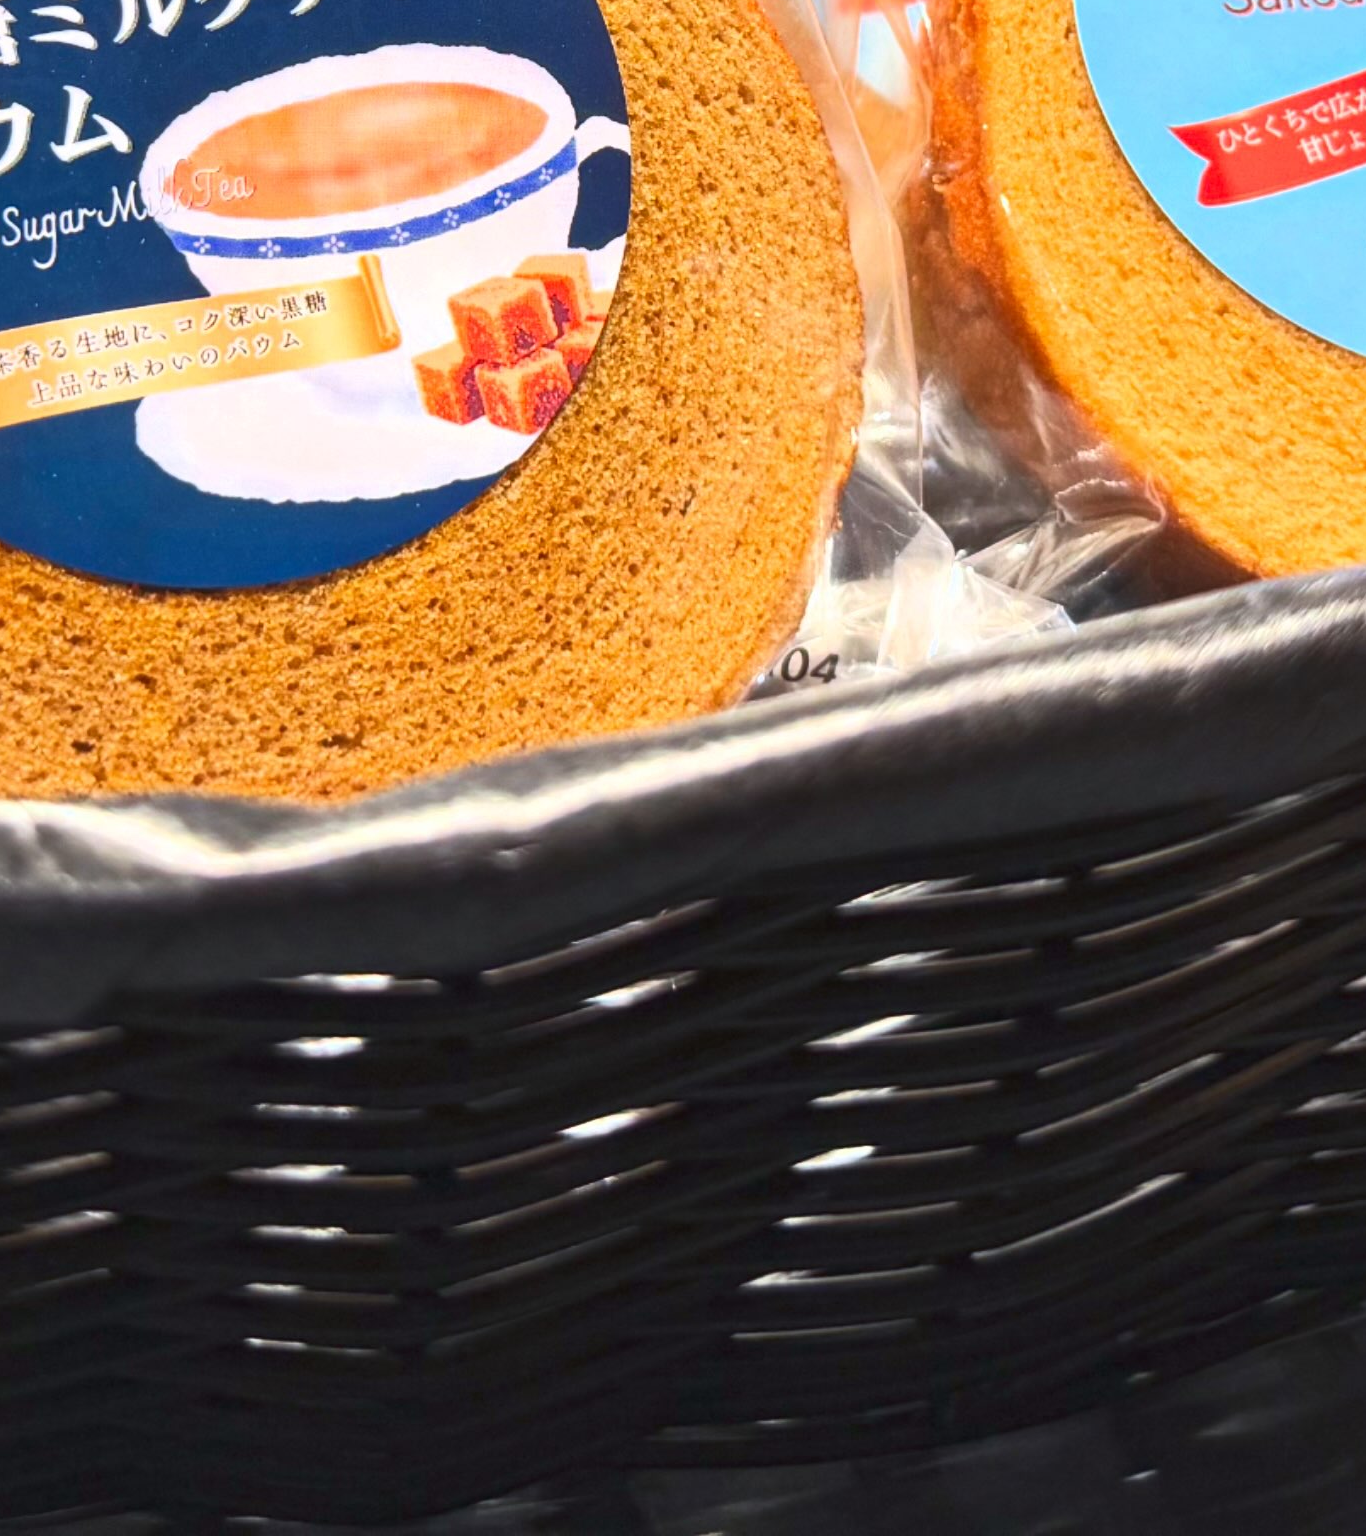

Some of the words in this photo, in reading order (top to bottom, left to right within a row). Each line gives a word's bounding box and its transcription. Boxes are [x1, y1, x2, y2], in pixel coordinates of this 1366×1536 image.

[1, 207, 97, 269] Sugar
[98, 158, 193, 227] Milk
[192, 165, 257, 210] Tea
[32, 332, 301, 406] 上品な味わいのバウム
[769, 647, 839, 684] 04
